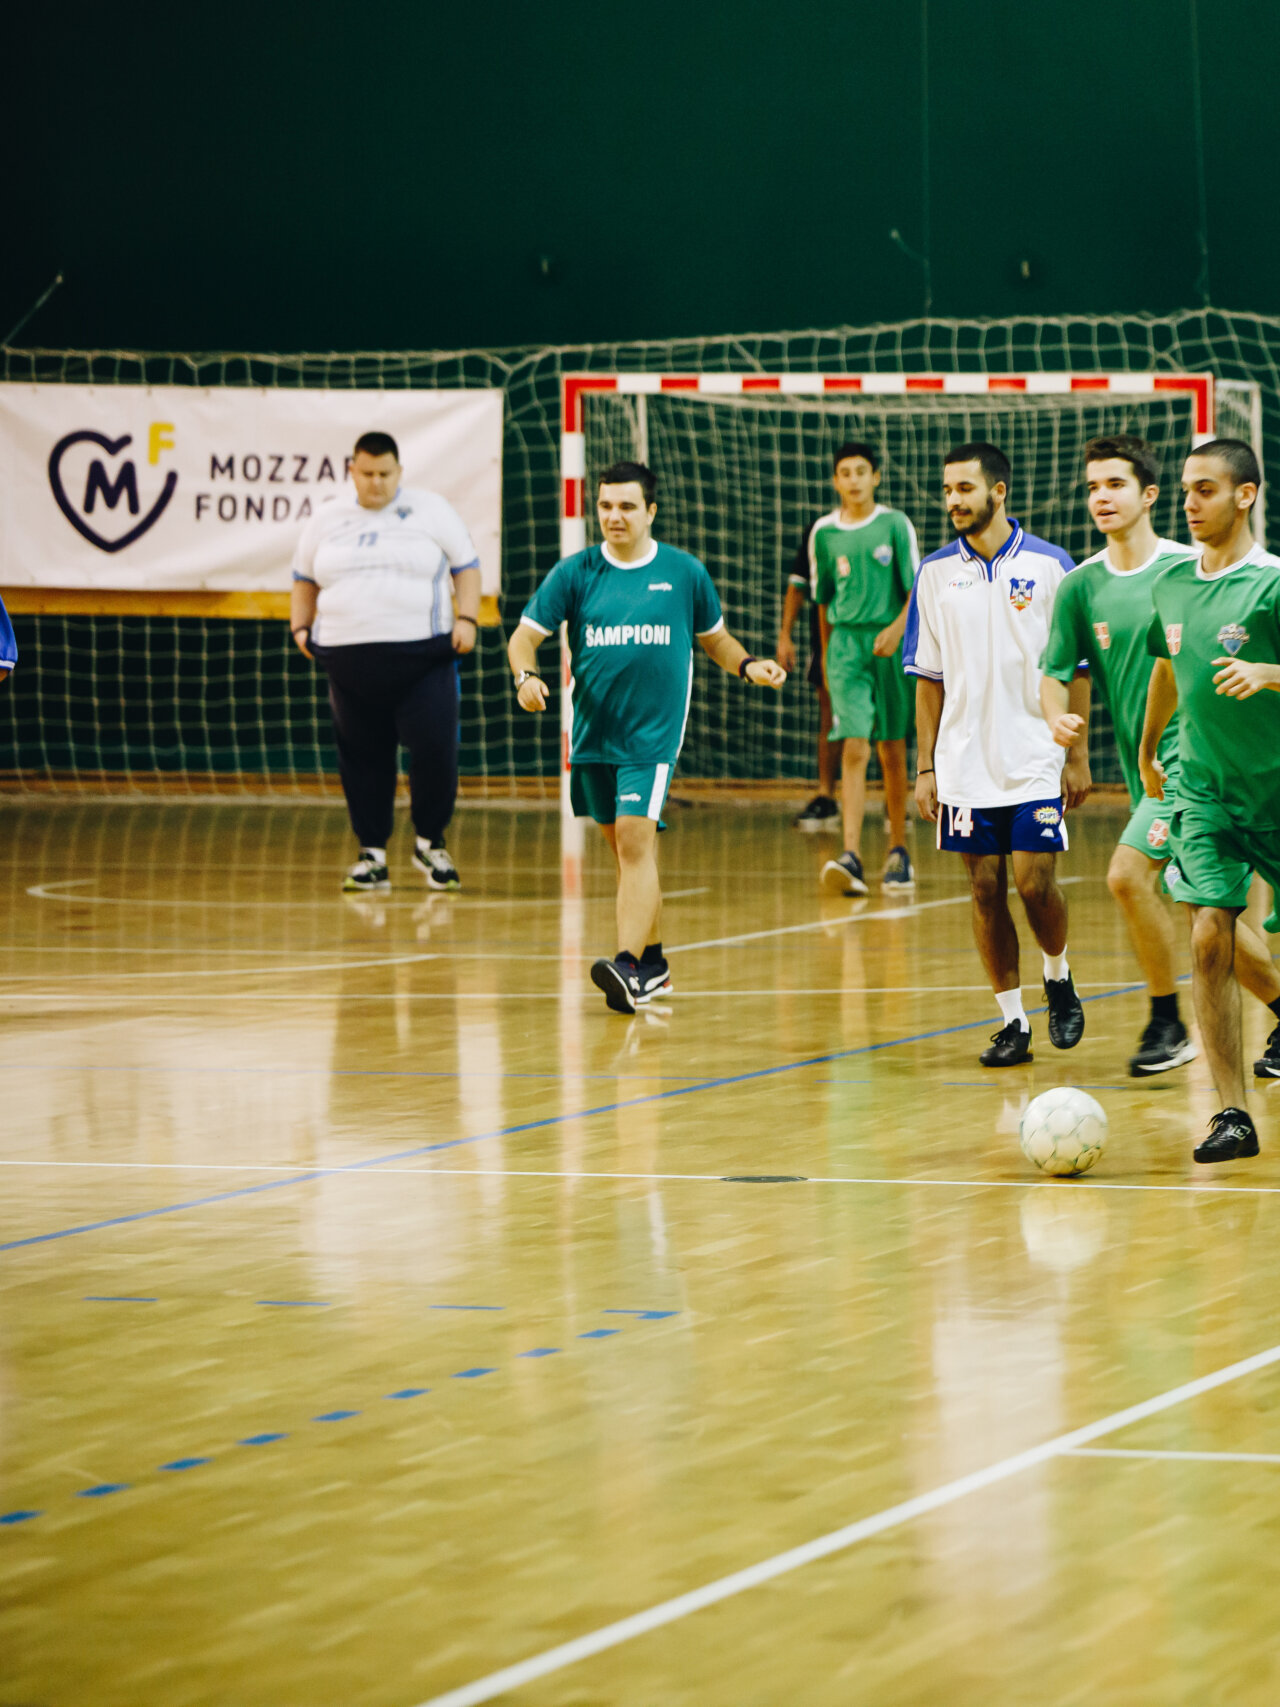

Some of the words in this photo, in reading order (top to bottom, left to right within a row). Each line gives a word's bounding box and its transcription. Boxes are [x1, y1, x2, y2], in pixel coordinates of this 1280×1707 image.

[195, 493, 337, 522] FONDA
[585, 624, 671, 648] ŠAMPIONI
[947, 804, 974, 837] 14
